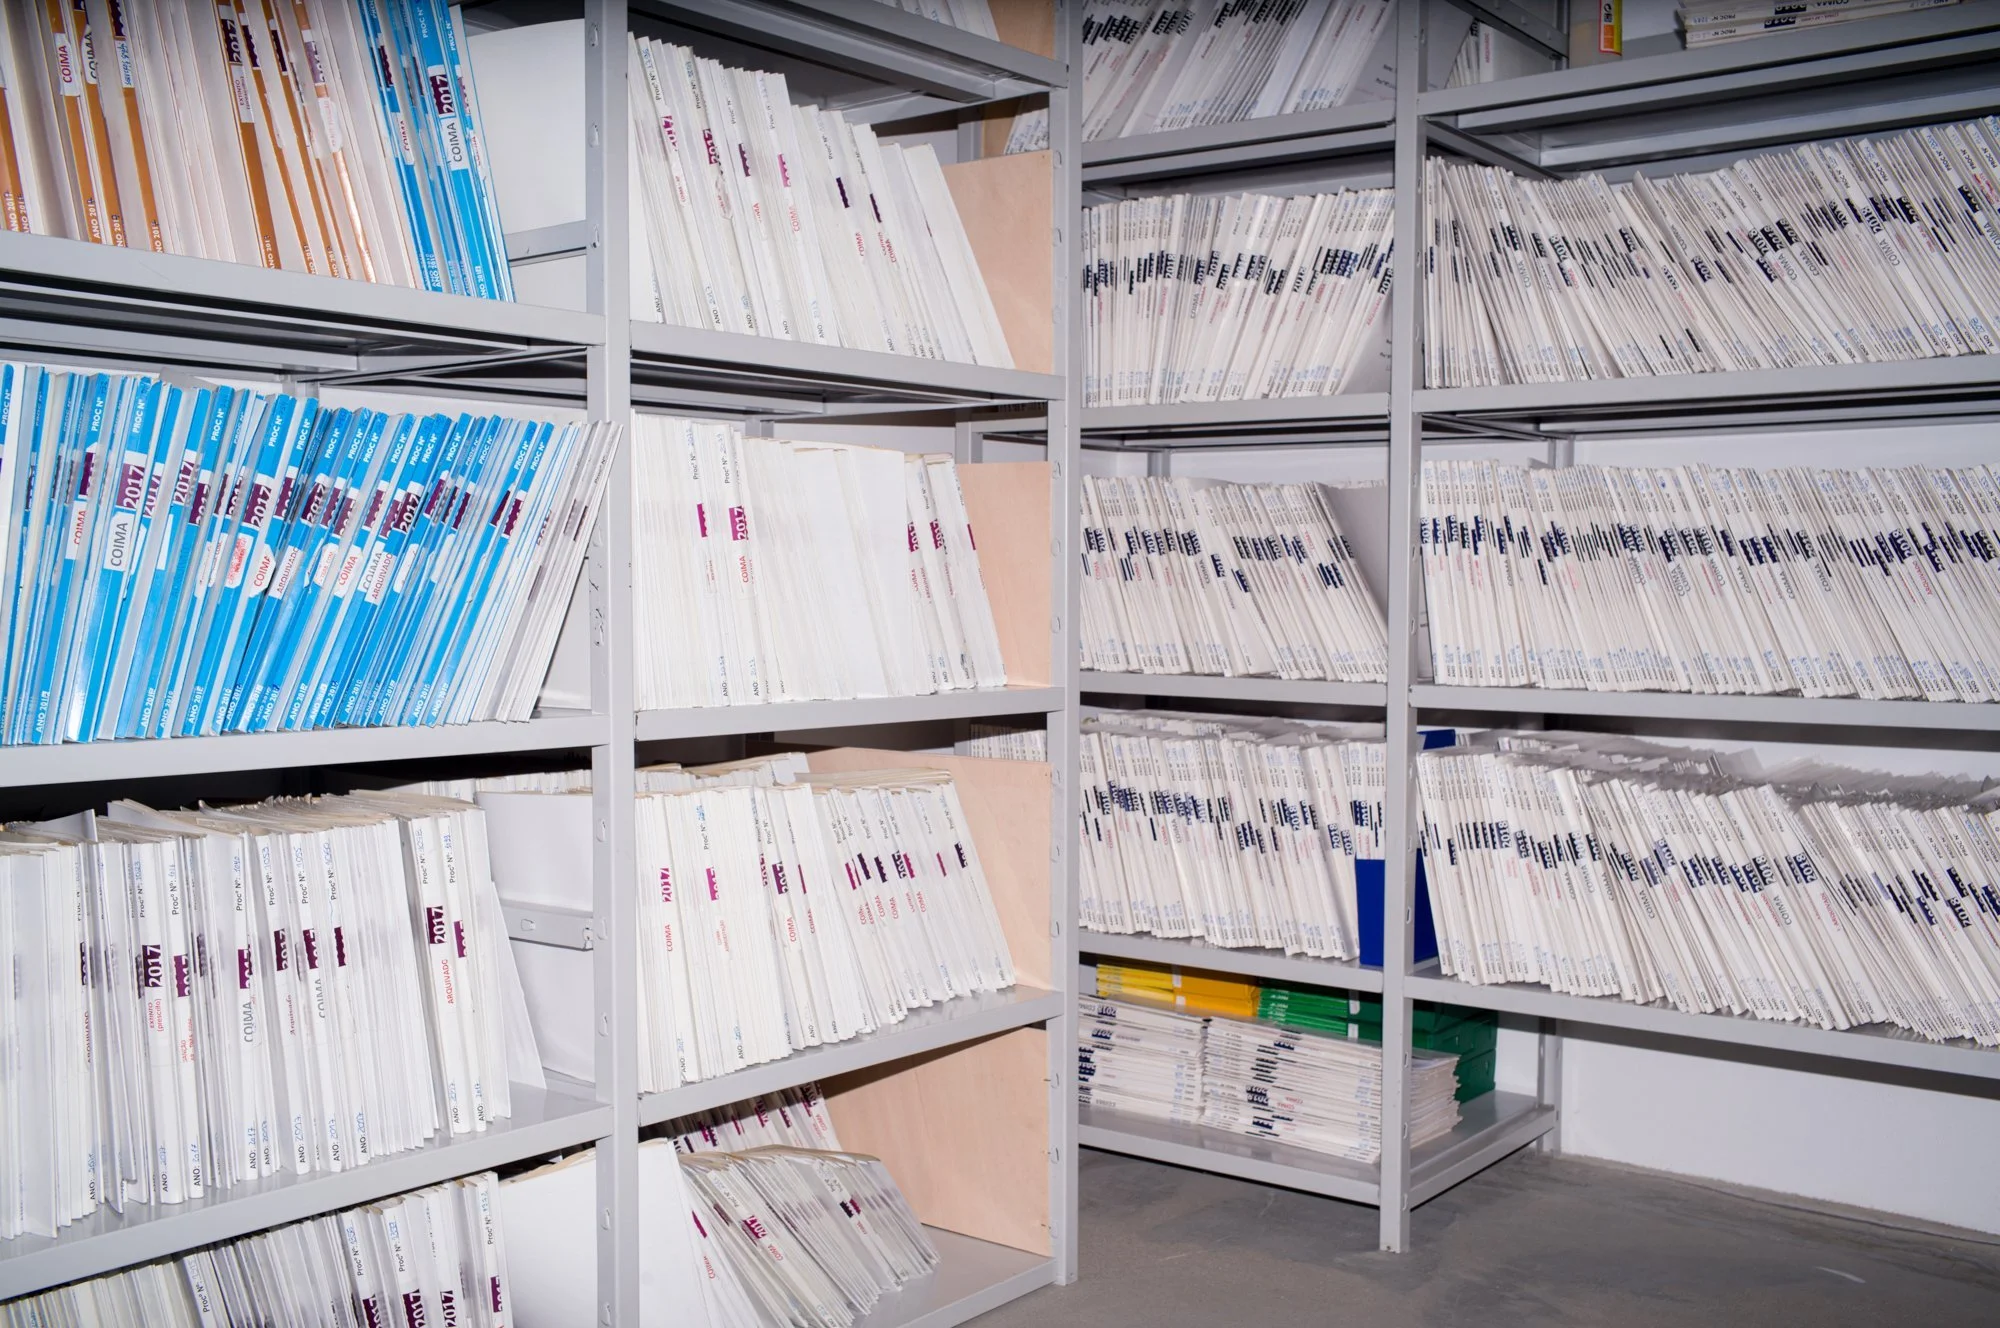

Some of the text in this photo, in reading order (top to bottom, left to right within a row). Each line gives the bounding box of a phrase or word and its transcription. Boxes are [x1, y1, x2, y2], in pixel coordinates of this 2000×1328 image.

[420, 18, 428, 38] PROC
[227, 19, 242, 63] 2017
[58, 45, 72, 83] COIMA
[437, 75, 455, 113] 2017
[449, 122, 462, 163] COIMA
[91, 218, 101, 239] ANO
[1879, 241, 1900, 267] COIMA
[1516, 258, 1532, 288] COIMA
[1778, 252, 1797, 281] COIMA
[1, 402, 10, 425] PROC
[91, 408, 102, 431] PROC
[133, 410, 144, 433] PROC
[211, 418, 222, 441] PROC
[269, 425, 280, 447] PROC
[296, 428, 308, 450] PROC
[325, 437, 337, 459] PROC
[348, 437, 360, 459] PROC
[363, 441, 376, 463] PROC
[391, 443, 403, 464] PROC
[410, 445, 422, 466] PROC
[422, 443, 434, 464] PROC
[446, 442, 458, 462] PROC
[479, 445, 490, 465] PROC
[513, 449, 527, 470] PROC
[530, 449, 543, 471] PROC
[123, 465, 145, 509] 2017
[174, 460, 195, 503] 2017
[251, 485, 272, 527] 2017
[307, 484, 326, 523] 2017
[400, 493, 420, 534] 2017
[74, 510, 87, 545] COIMA
[734, 506, 747, 540] 2017
[111, 522, 128, 567] COIMA
[253, 555, 271, 587] COIMA
[339, 555, 358, 586] COIMA
[372, 552, 393, 599] ARQUIVADO
[739, 555, 749, 583] COIMA
[1814, 562, 1831, 592] COIMA
[188, 705, 199, 724] ANO
[263, 702, 273, 721] ANO
[289, 701, 301, 721] ANO
[344, 695, 355, 714] ANO
[378, 697, 390, 716] ANO
[413, 699, 425, 718] ANO
[36, 712, 46, 733] ANO
[141, 707, 152, 728] ANO
[160, 709, 170, 729] ANO
[215, 706, 226, 727] ANO
[1755, 855, 1776, 886] 2018
[1796, 854, 1817, 884] 2018
[268, 884, 276, 906] Procº
[301, 883, 309, 904] Procº
[660, 867, 672, 902] 2017
[171, 893, 179, 915] Procº
[1638, 889, 1655, 919] COIMA
[1773, 895, 1792, 925] COIMA
[432, 905, 445, 944] 2017
[785, 916, 797, 942] COIMA
[663, 923, 673, 952] COIMA
[148, 945, 162, 987] 2017
[441, 959, 454, 1005] ARQUIVADO
[154, 998, 164, 1032] (prescrito)
[243, 1001, 254, 1043] COIMA
[477, 1103, 485, 1122] ANO:
[294, 1116, 305, 1142] 2017
[329, 1118, 339, 1139] 2017
[247, 1127, 257, 1169] ANO: 2017
[359, 1132, 368, 1154] ANO:
[161, 1170, 169, 1192] ANO:
[193, 1164, 201, 1186] ANO:
[355, 1255, 363, 1276] Procº
[200, 1293, 210, 1312] Procº
[410, 1290, 425, 1327] 2017
[441, 1290, 456, 1328] 2017
